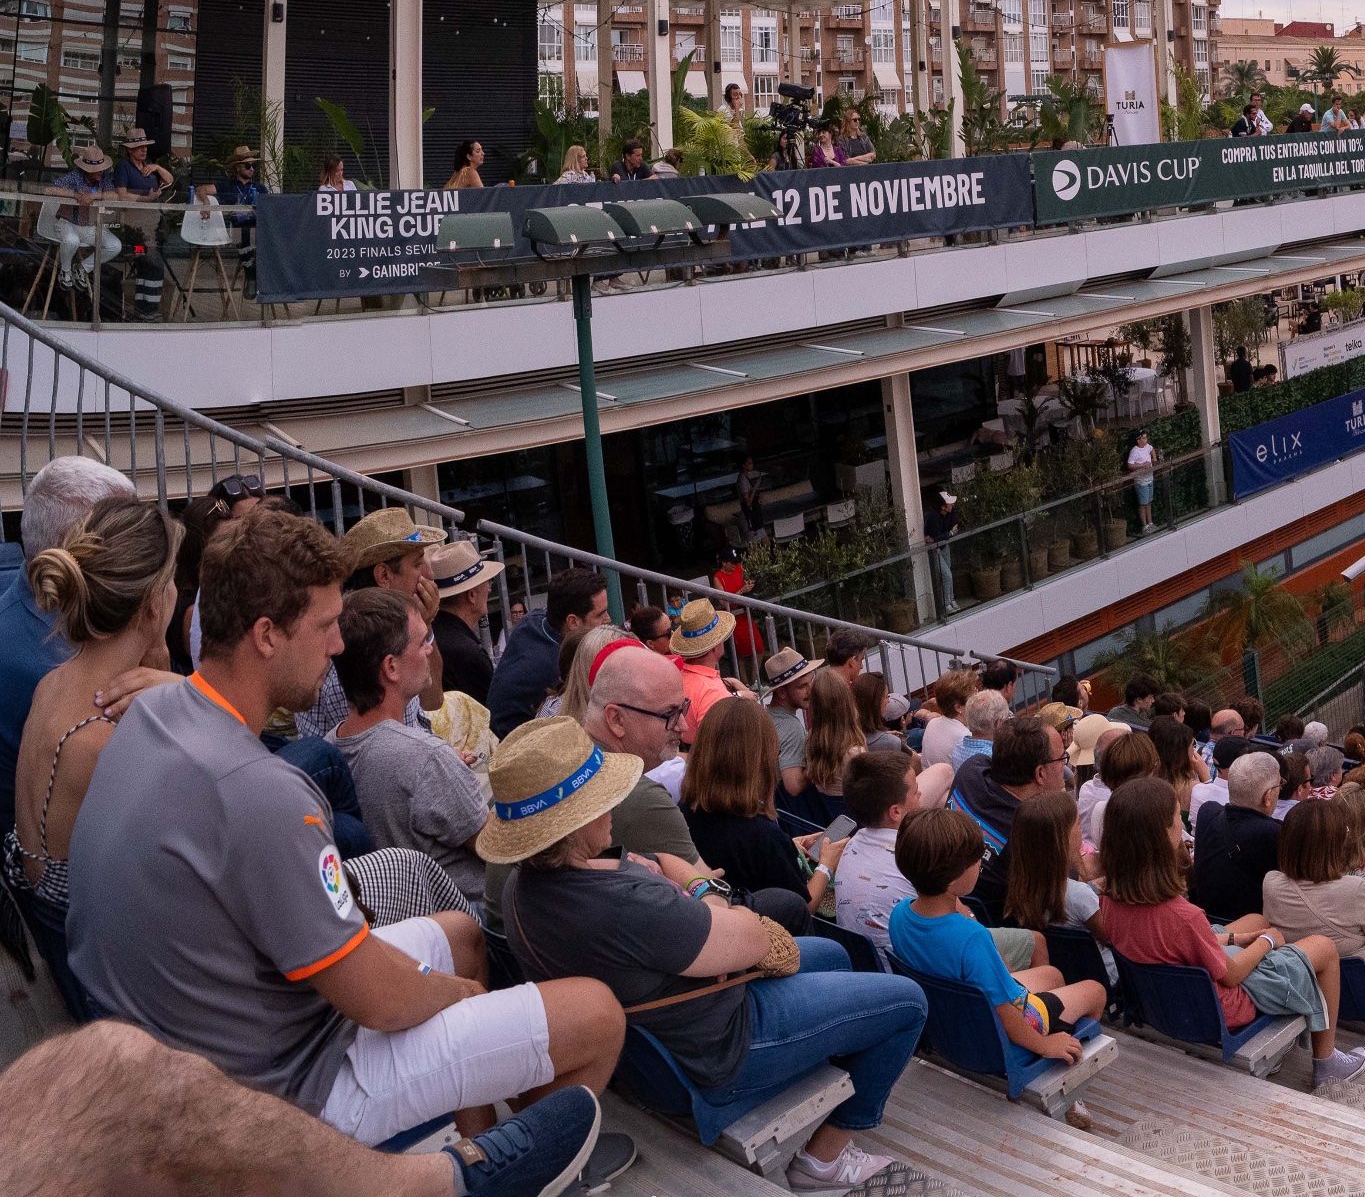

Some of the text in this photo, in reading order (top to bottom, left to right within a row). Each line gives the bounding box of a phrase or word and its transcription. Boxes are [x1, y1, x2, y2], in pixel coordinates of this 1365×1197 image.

[1116, 101, 1145, 110] TURIA
[1221, 146, 1257, 164] COMPRA
[1258, 145, 1276, 160] TUS
[1277, 141, 1318, 159] ENTRADAS
[1319, 140, 1335, 155] CON
[1336, 139, 1347, 153] UN
[1348, 138, 1364, 152] 10%
[1087, 157, 1200, 189] DAVIS CUP
[1273, 167, 1284, 182] EN
[1286, 166, 1297, 181] LA
[1298, 161, 1335, 180] TAQUILLA
[1335, 161, 1350, 175] DEL
[316, 190, 460, 216] BILLIE JEAN
[772, 188, 802, 226] 12
[808, 184, 843, 224] DE
[851, 172, 985, 218] NOVIEMBRE
[331, 216, 394, 240] KING
[326, 244, 437, 259] 2023 FINALS SEVIL
[339, 261, 441, 278] BY GAINBRI
[1345, 339, 1363, 352] teika
[1256, 431, 1302, 462] elix
[572, 768, 593, 789] BBVA
[520, 799, 548, 816] BBVA
